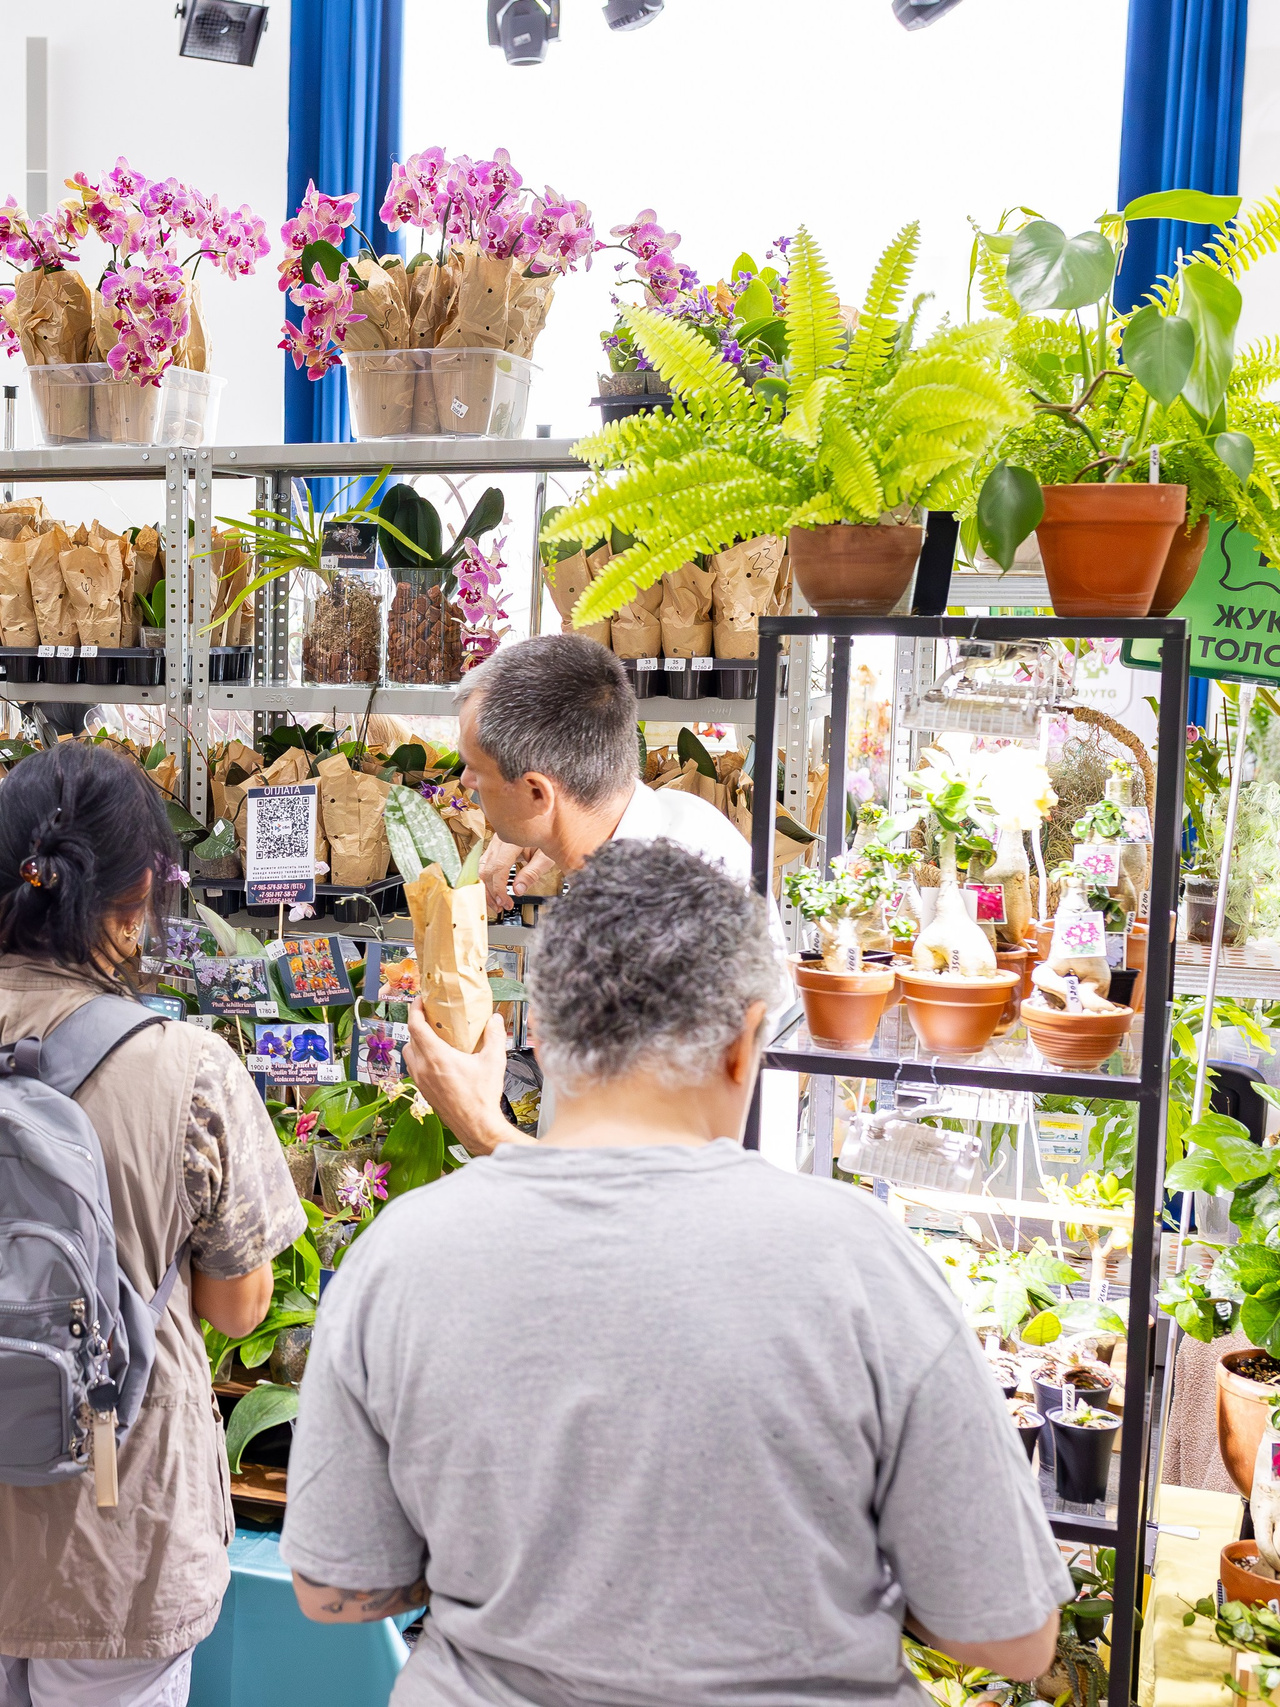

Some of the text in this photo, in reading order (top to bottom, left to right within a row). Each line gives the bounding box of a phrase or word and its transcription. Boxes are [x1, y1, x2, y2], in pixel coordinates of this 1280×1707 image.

[264, 786, 301, 796] ОПЛАТА
[1141, 893, 1149, 915] 4200
[847, 948, 855, 972] 4000
[952, 949, 961, 972] 3500
[1069, 979, 1079, 1003] 3200
